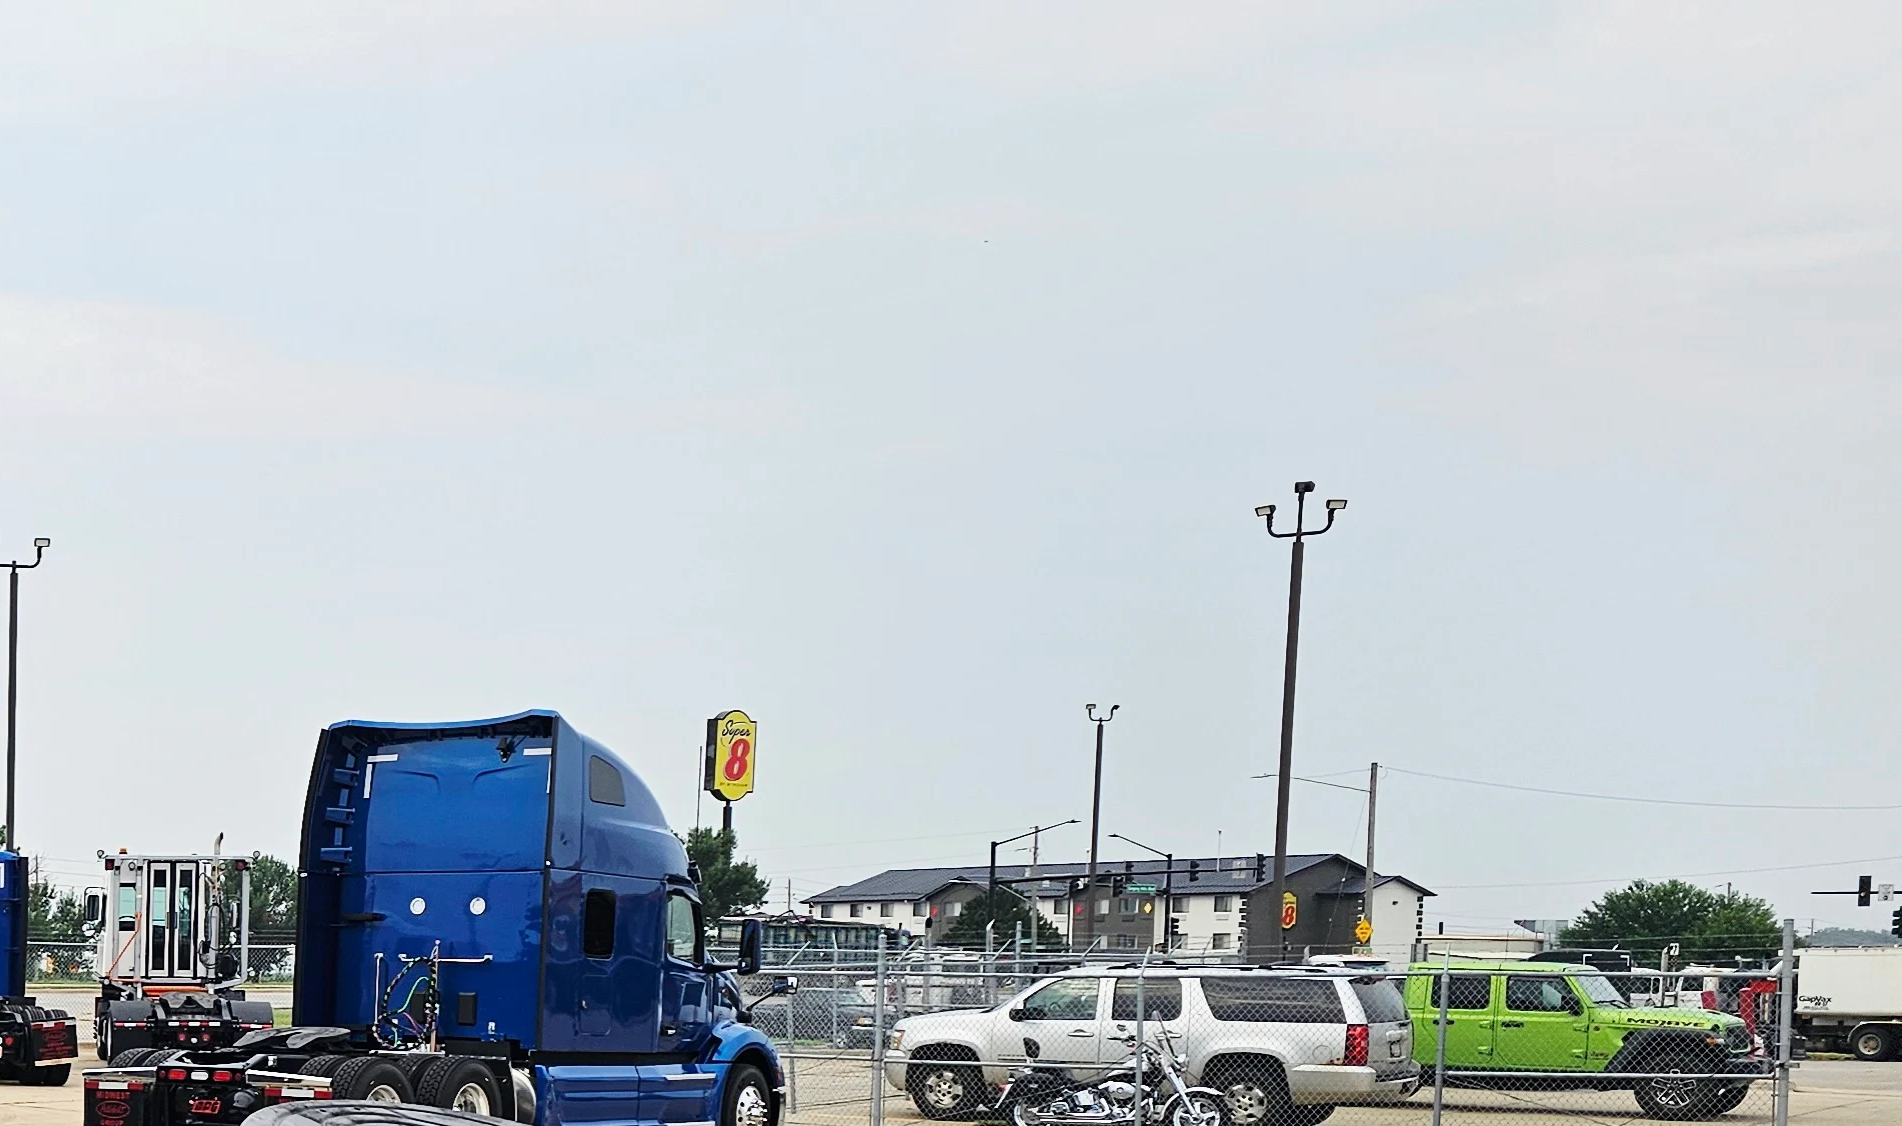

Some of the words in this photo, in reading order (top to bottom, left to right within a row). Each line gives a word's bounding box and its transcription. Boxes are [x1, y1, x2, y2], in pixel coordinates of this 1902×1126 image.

[722, 720, 751, 744] Super
[724, 738, 750, 781] 8
[1282, 906, 1295, 925] 8
